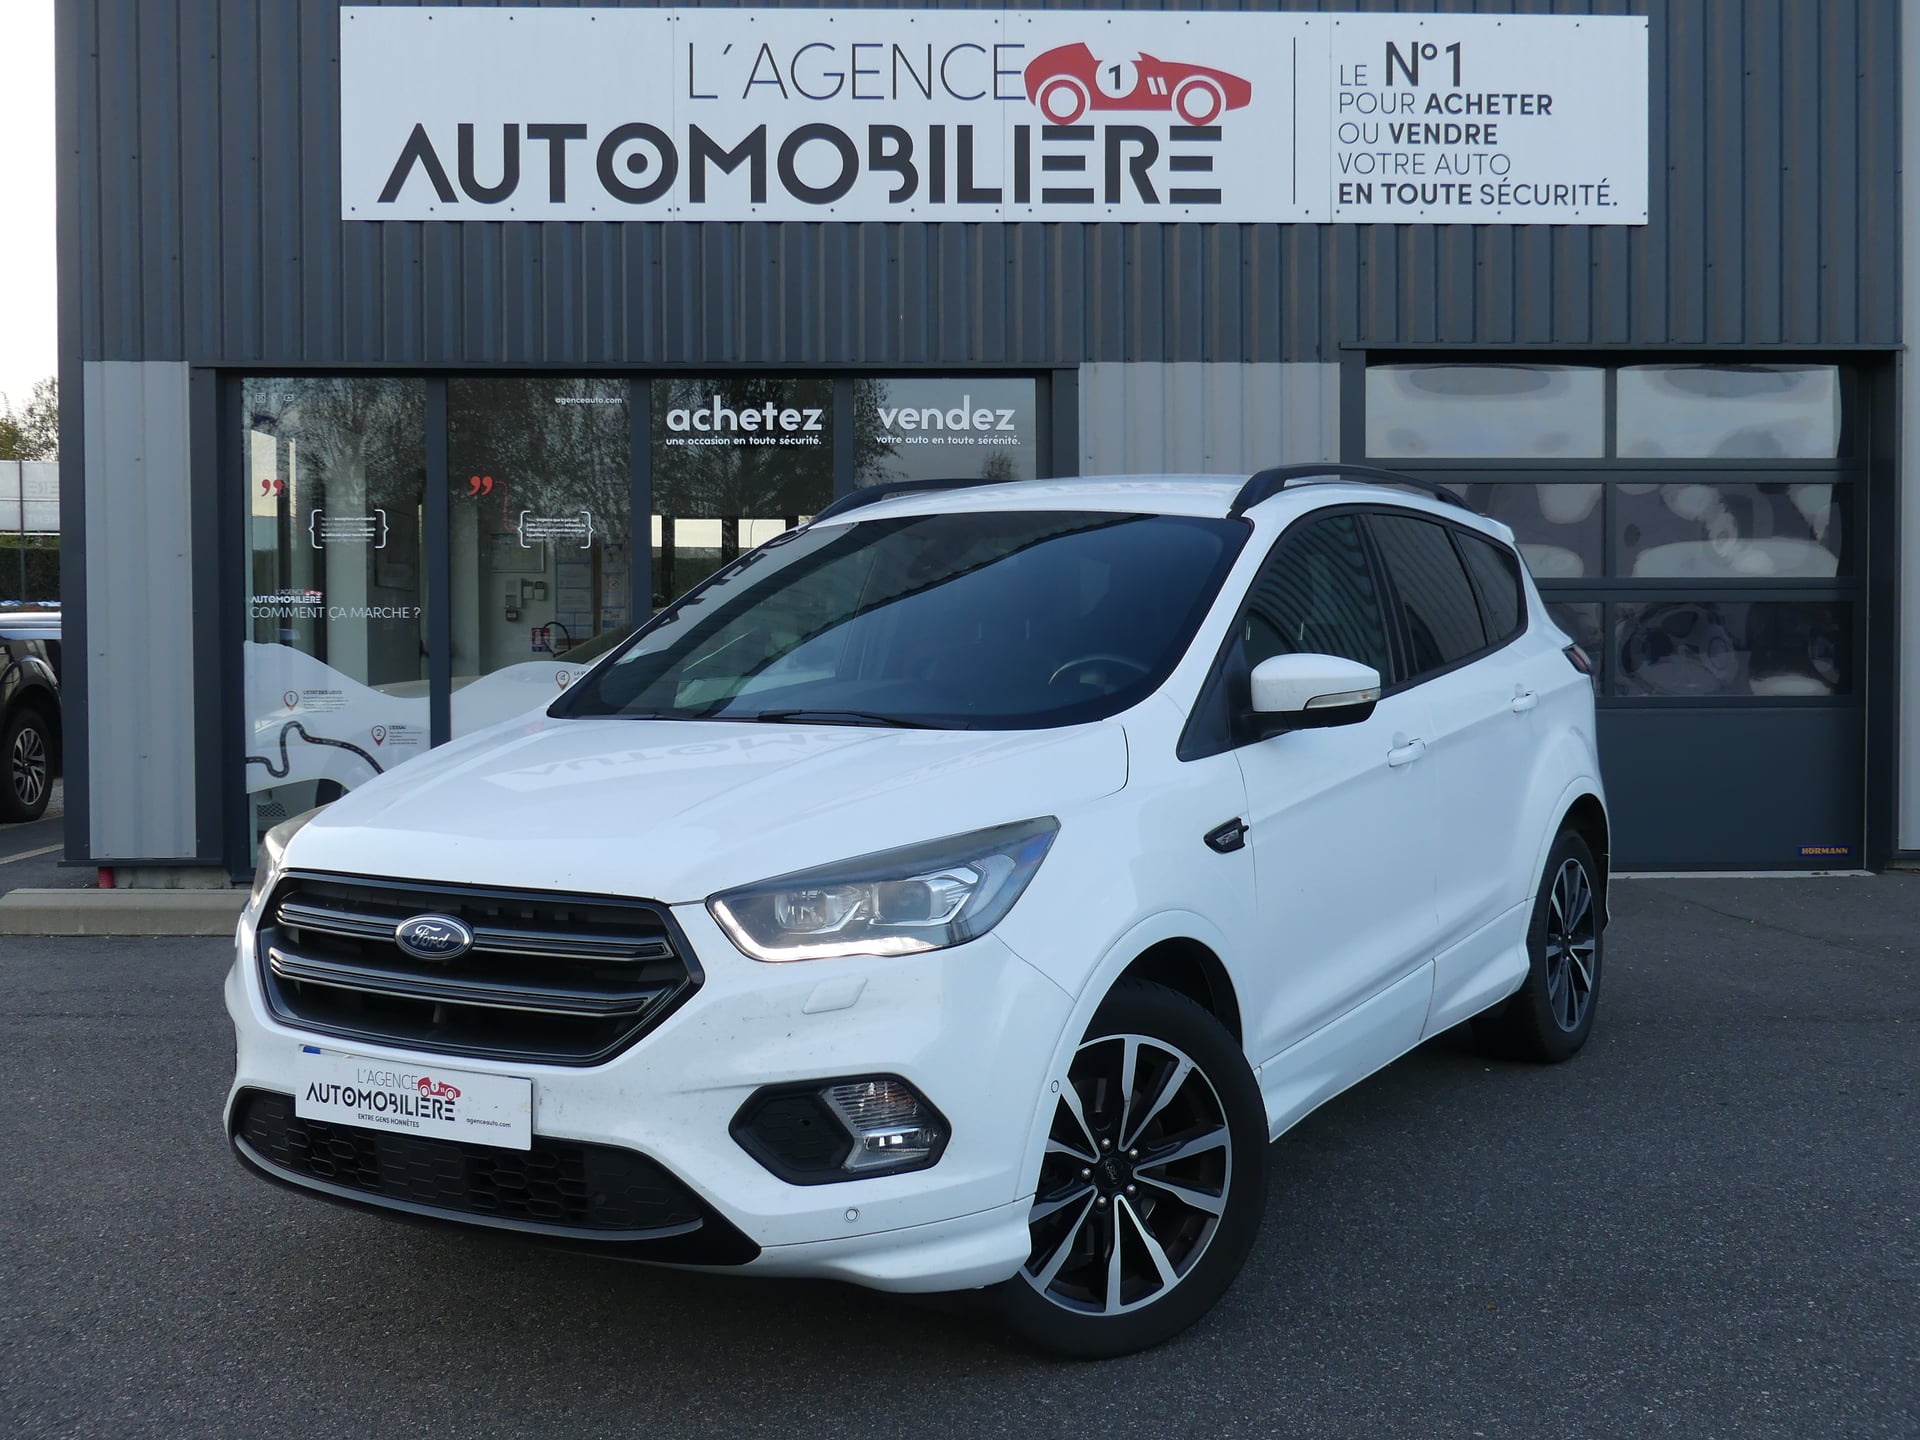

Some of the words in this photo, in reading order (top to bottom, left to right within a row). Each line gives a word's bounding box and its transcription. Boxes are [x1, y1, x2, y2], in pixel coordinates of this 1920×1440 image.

[1108, 64, 1121, 91] 1
[1339, 64, 1367, 87] LE
[1338, 93, 1416, 115] POUR
[1424, 93, 1553, 116] ACHETER
[1338, 123, 1381, 146] OU
[1388, 123, 1498, 146] VENDRE
[1338, 152, 1426, 176] VOTRE
[1433, 152, 1511, 176] AUTO
[1339, 183, 1373, 205] EN
[1381, 183, 1473, 206] TOUTE
[1480, 176, 1618, 207] SÉCURITÉ.
[554, 396, 623, 406] agenceauto.com
[877, 394, 1016, 431] vendez
[666, 394, 823, 432] achetez
[666, 437, 685, 446] une
[687, 435, 731, 446] occasion
[733, 437, 746, 446] en
[749, 435, 777, 446] toute
[779, 434, 822, 446] sécurité.
[876, 435, 903, 445] votre
[905, 435, 930, 445] auto
[932, 437, 945, 445] en
[948, 435, 975, 445] toute
[978, 434, 1021, 446] sérénité.
[250, 606, 326, 619] COMMENT
[329, 606, 348, 621] ÇA
[350, 606, 410, 619] MARCHE
[413, 606, 421, 619] ?
[376, 728, 383, 737] 2
[410, 924, 451, 949] Ford
[357, 1113, 375, 1121] ENTRE
[375, 1115, 390, 1124] GENS
[466, 1117, 512, 1129] agenceauto.com
